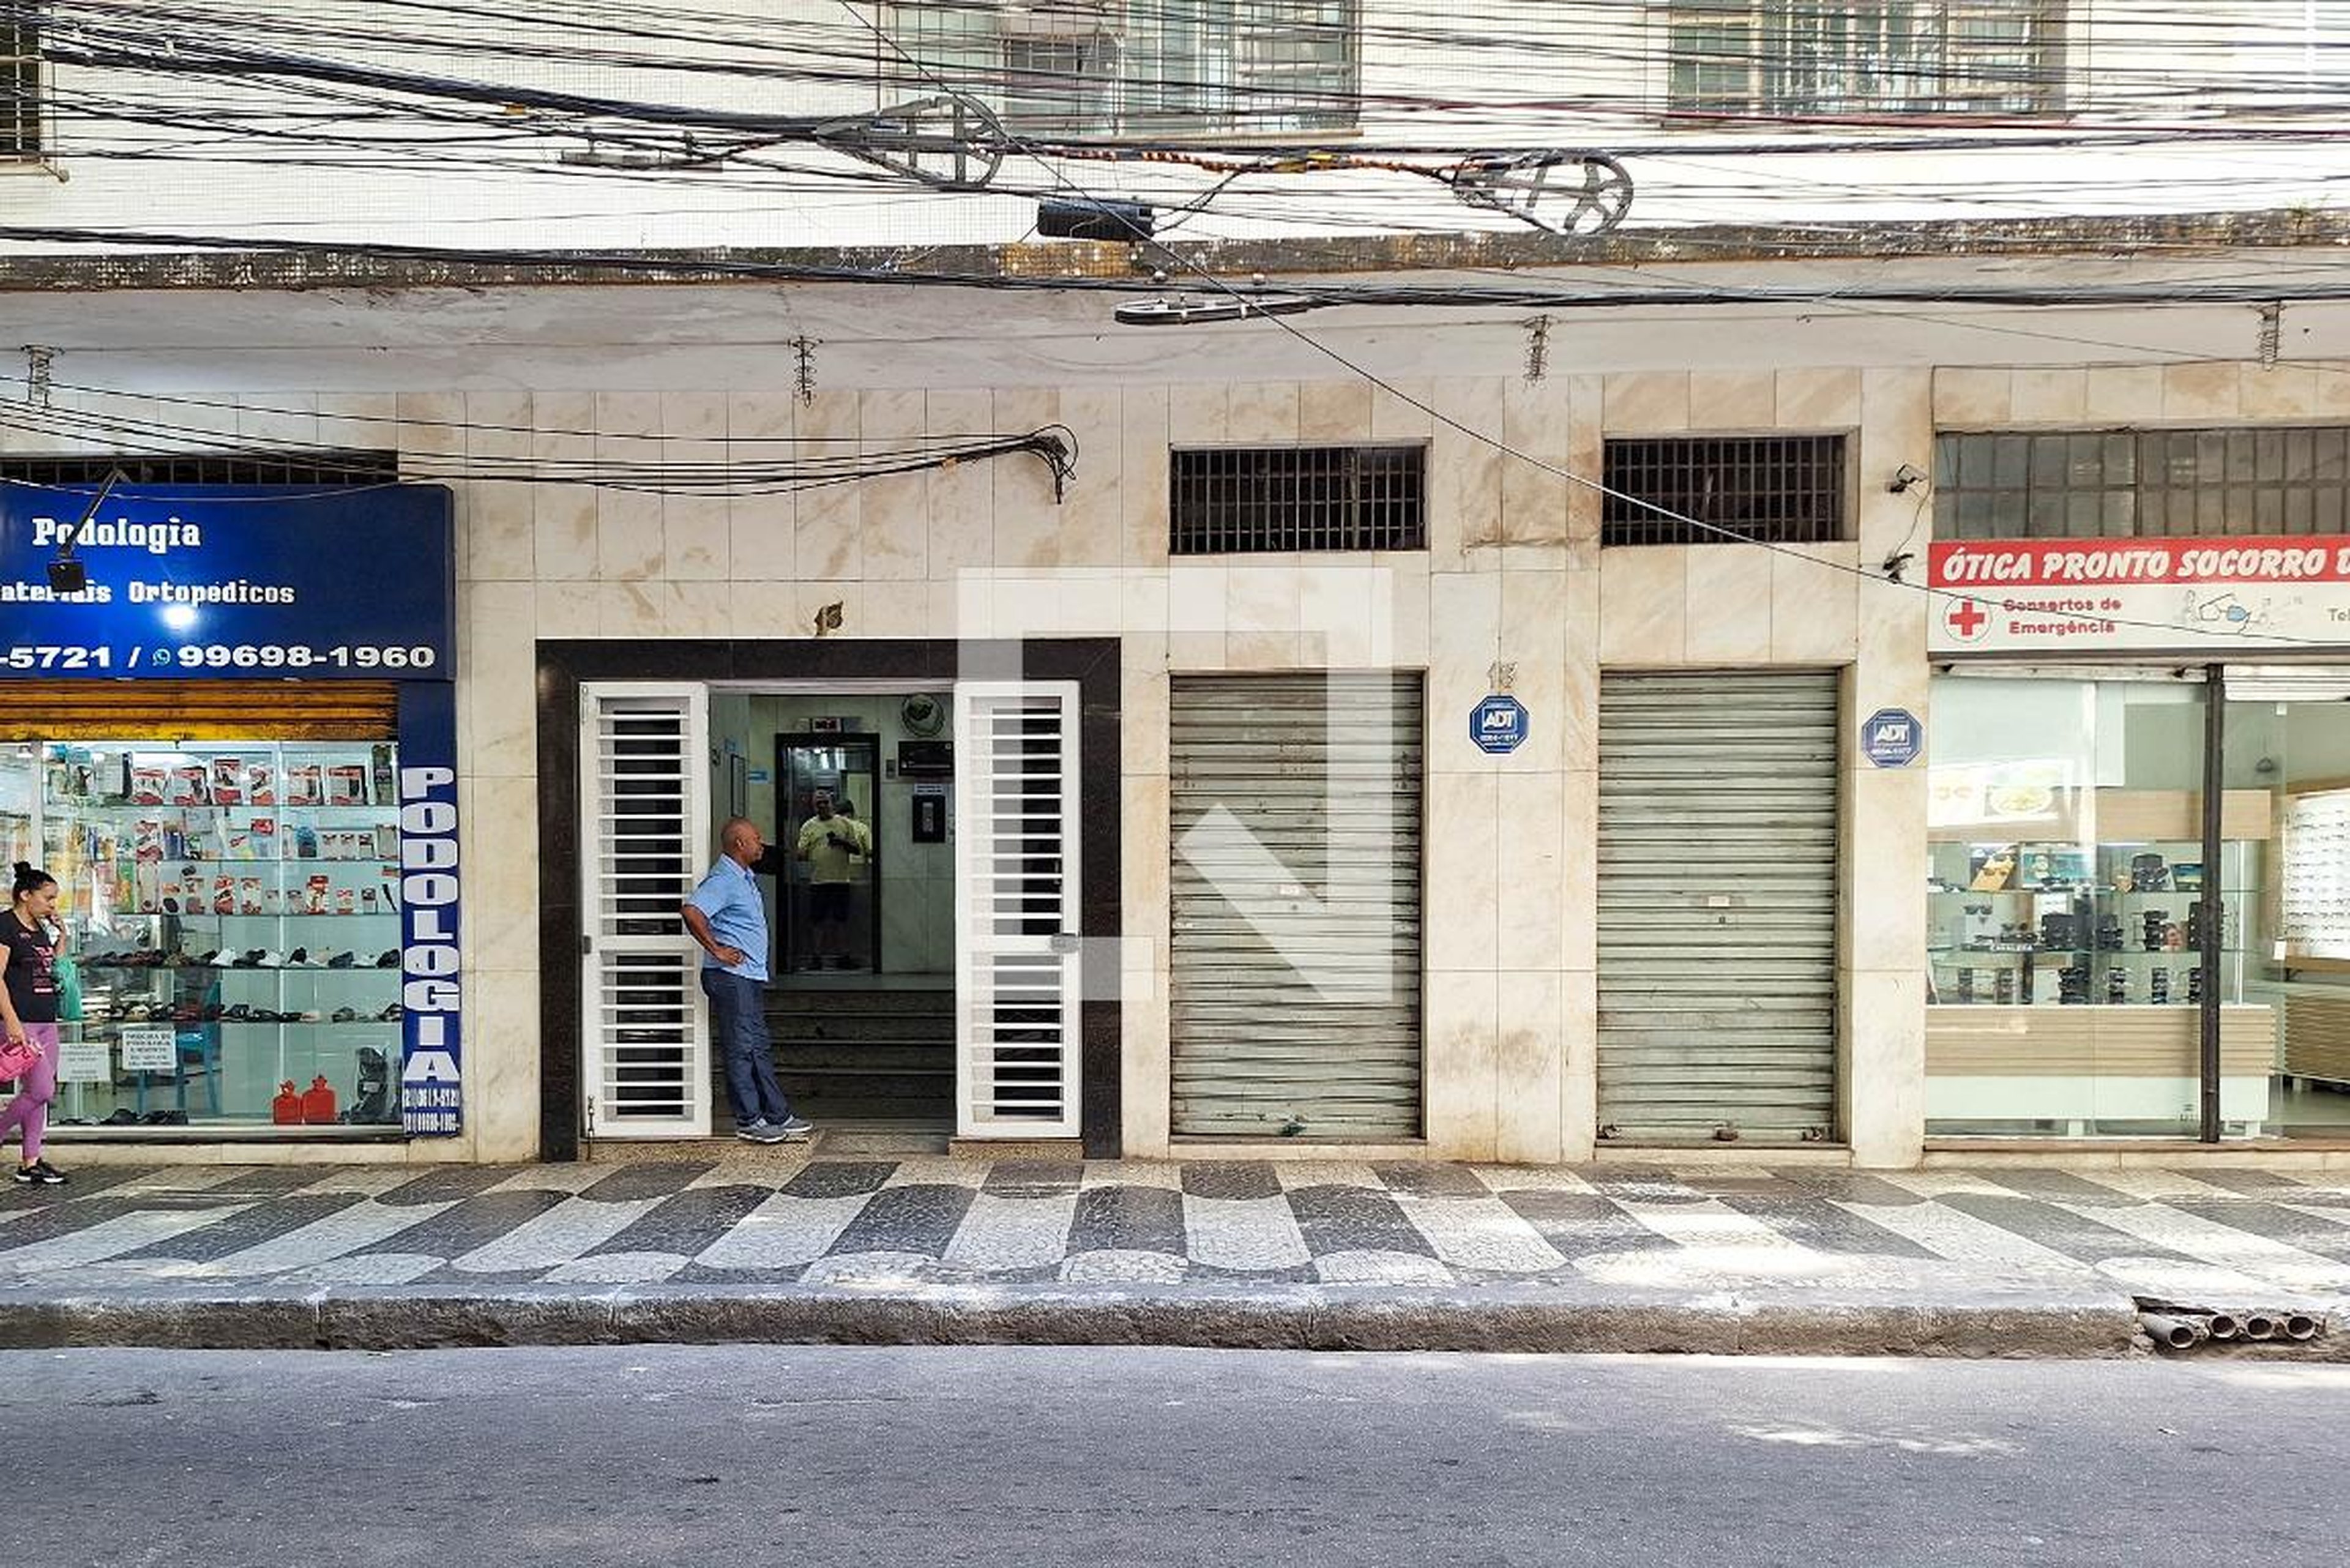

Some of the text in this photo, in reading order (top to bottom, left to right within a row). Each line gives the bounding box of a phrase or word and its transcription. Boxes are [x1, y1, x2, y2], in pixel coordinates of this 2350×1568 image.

[32, 517, 201, 554] Podologia
[1942, 546, 2032, 582] ÓTICA
[2042, 550, 2171, 581] PRONTO
[2176, 548, 2326, 579] SOCORRO
[2004, 598, 2122, 611] Consertos de
[2009, 620, 2115, 637] Emergência
[177, 646, 435, 668] 99698-1960
[1484, 709, 1516, 727] ADT
[1874, 724, 1909, 742] ADT
[401, 767, 460, 1081] PODOLOGIA
